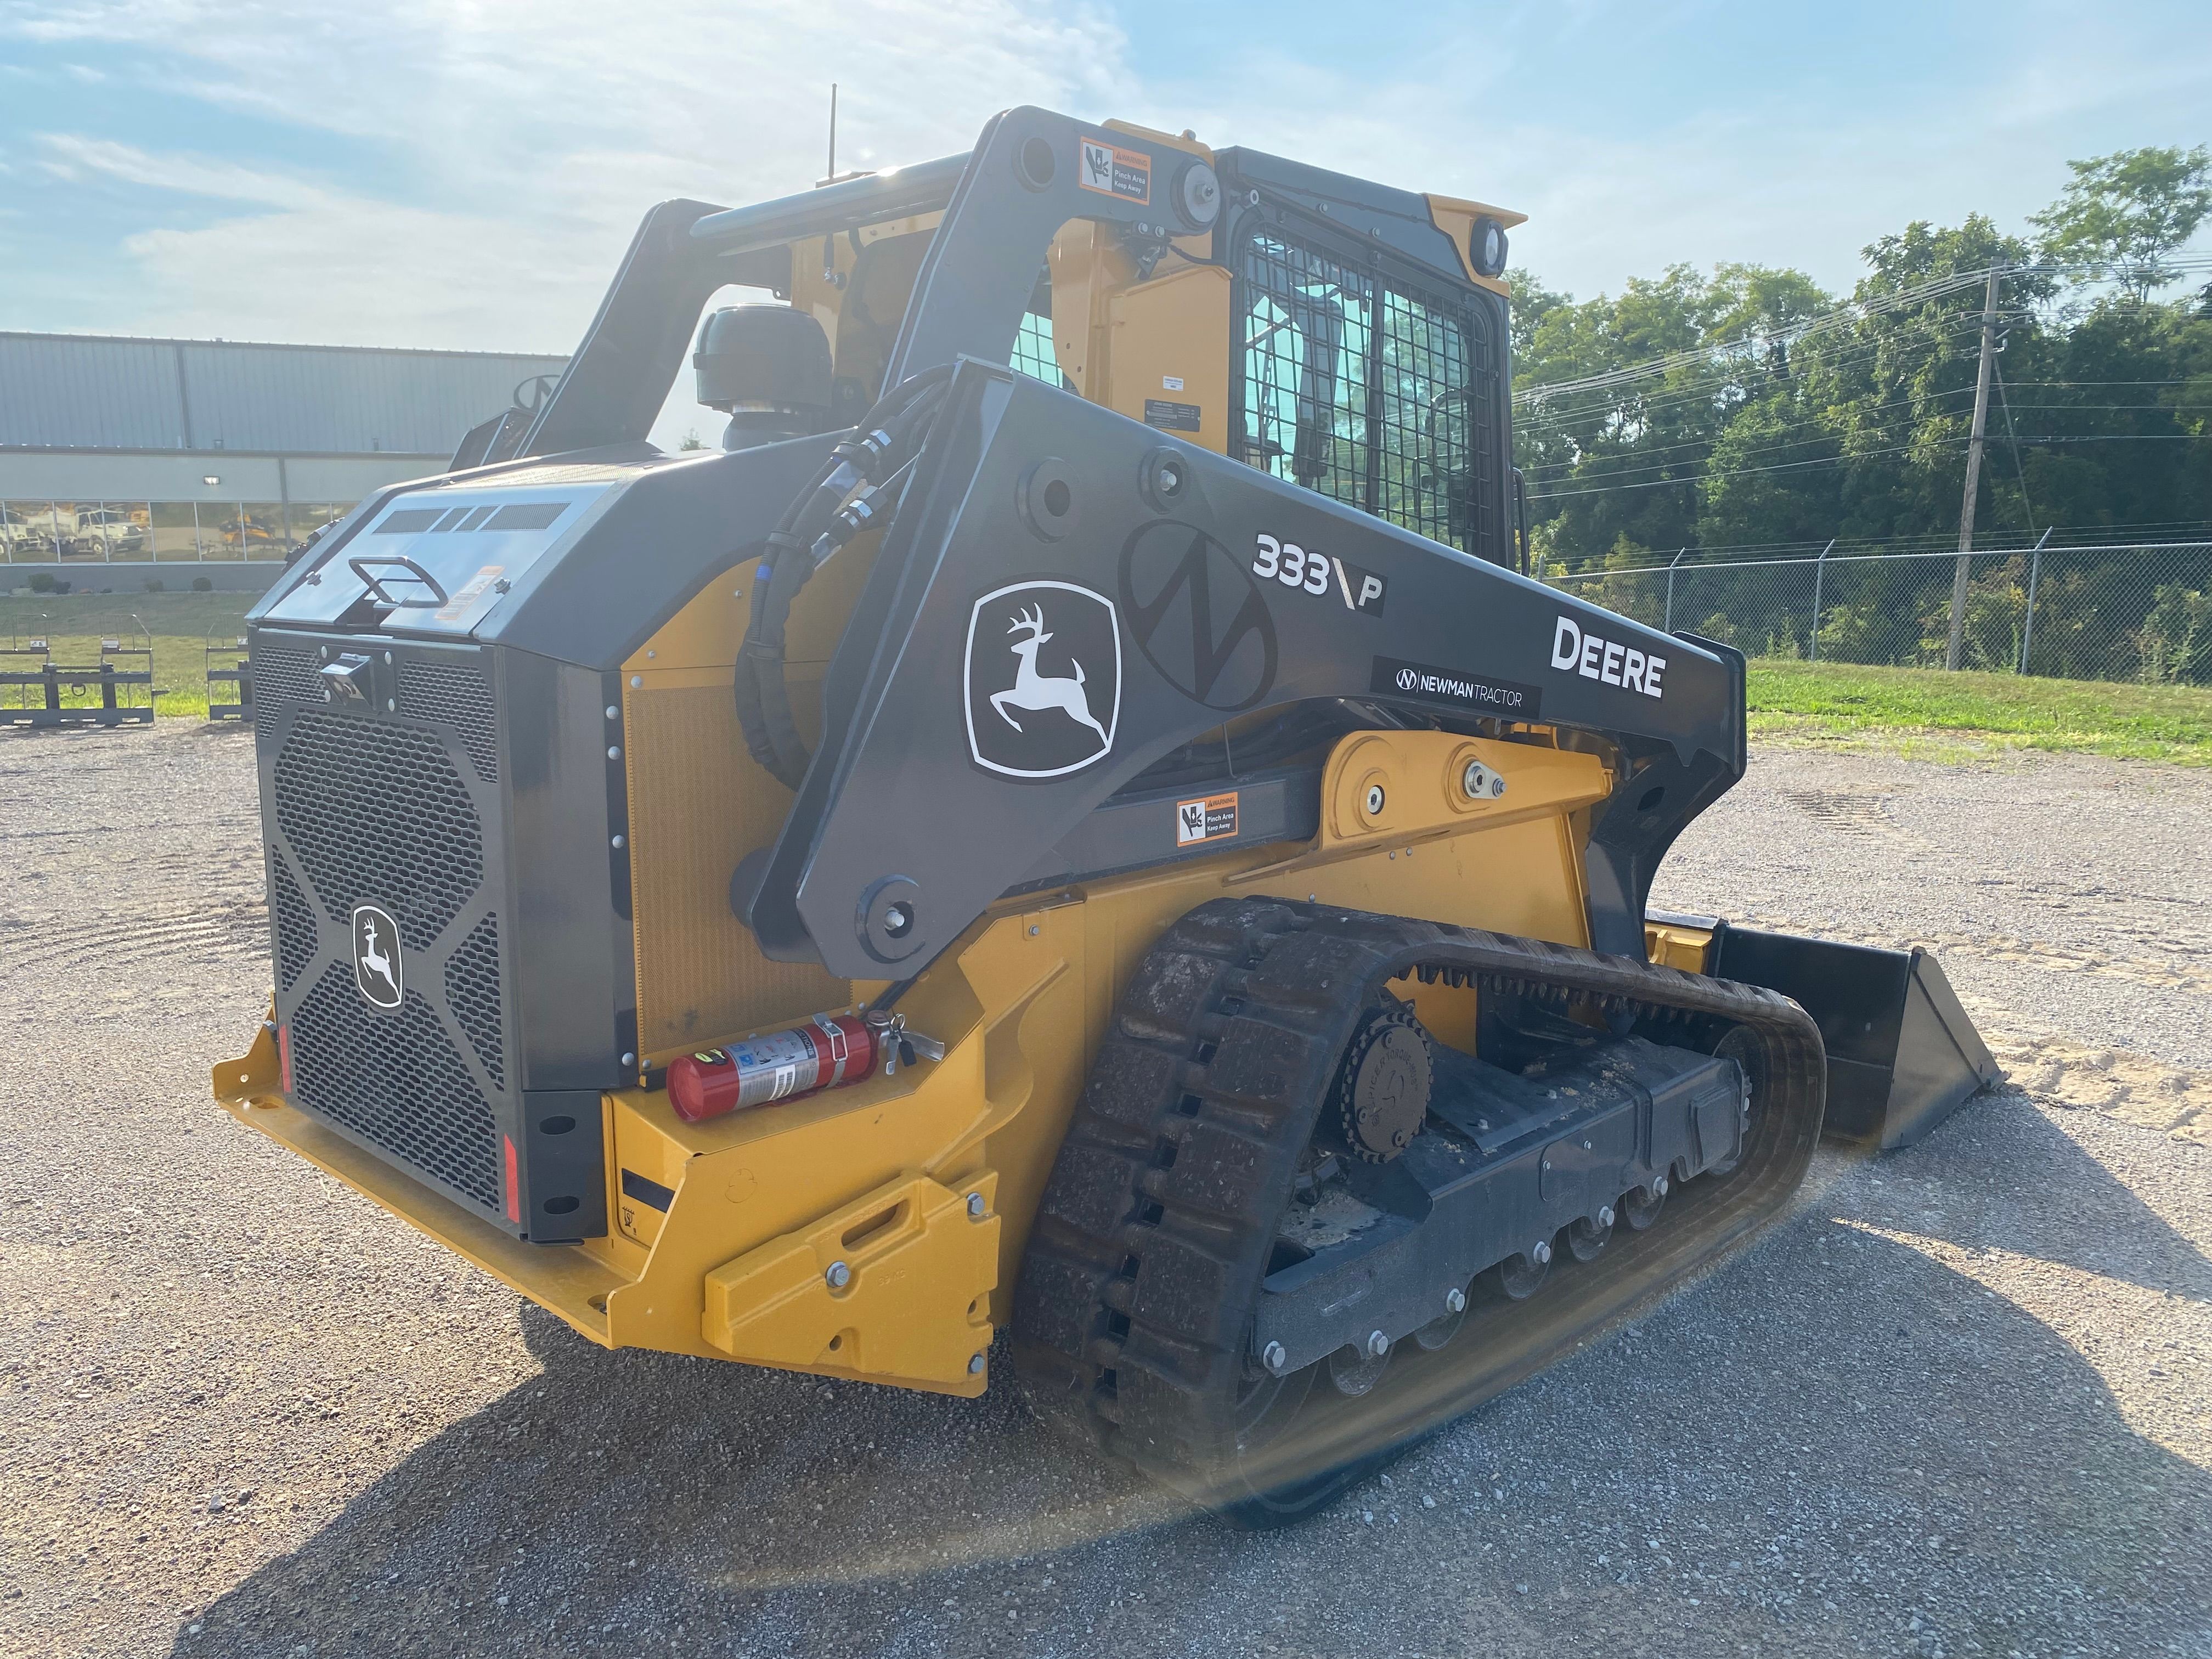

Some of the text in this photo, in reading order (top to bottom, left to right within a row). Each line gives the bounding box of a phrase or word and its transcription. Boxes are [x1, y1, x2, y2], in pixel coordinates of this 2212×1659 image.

[1122, 154, 1148, 167] WARNING
[1114, 170, 1146, 184] Pinch Area
[1114, 180, 1142, 194] Keep Away
[1550, 615, 1667, 698] DEERE
[1212, 797, 1234, 806] WARNING
